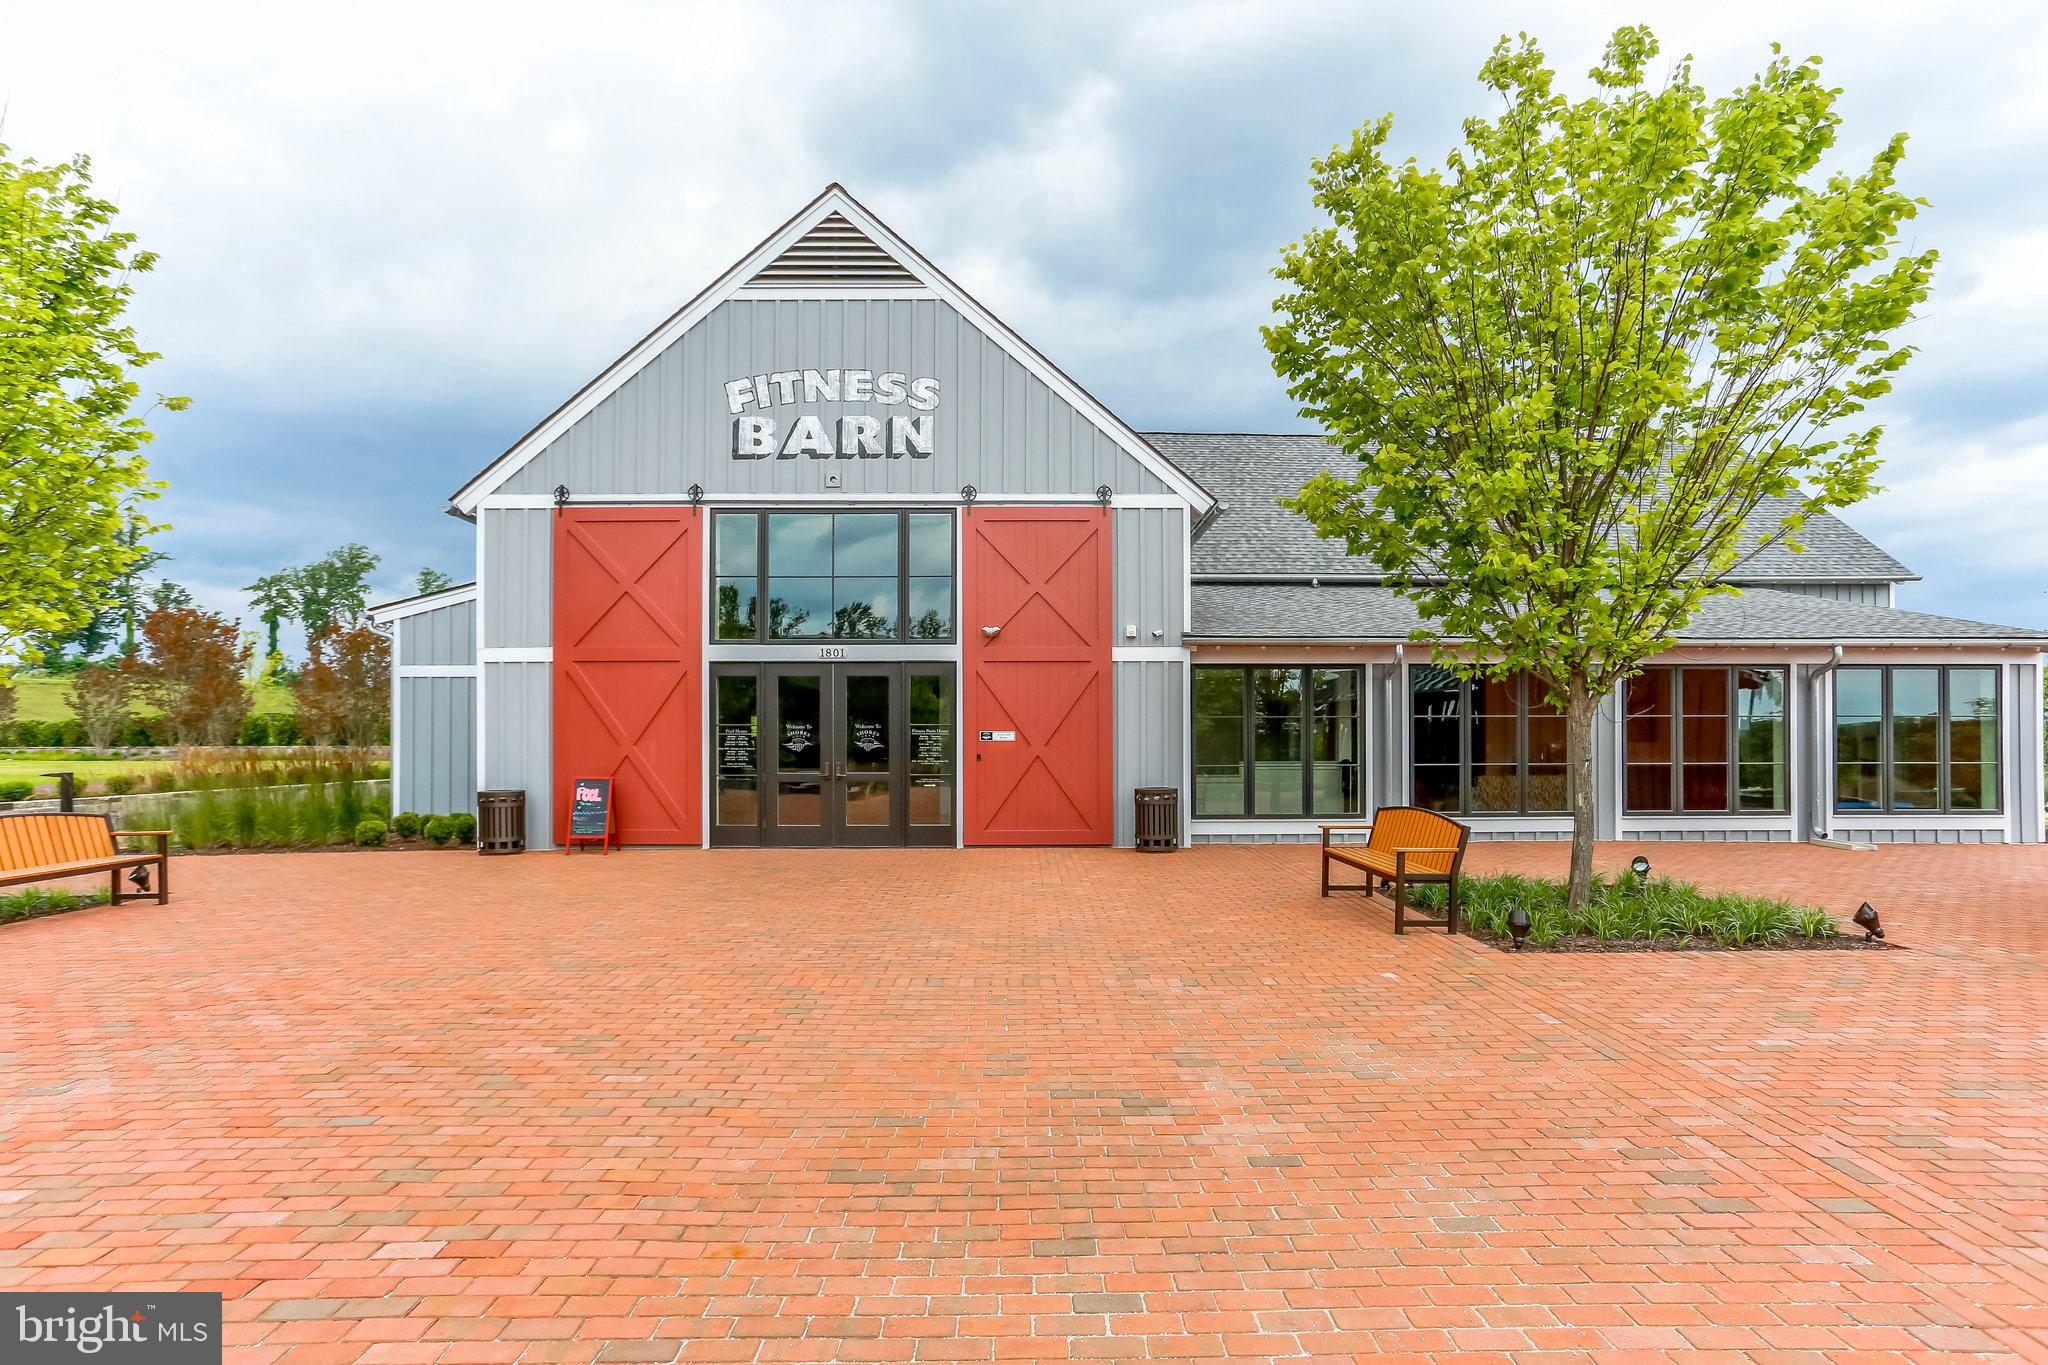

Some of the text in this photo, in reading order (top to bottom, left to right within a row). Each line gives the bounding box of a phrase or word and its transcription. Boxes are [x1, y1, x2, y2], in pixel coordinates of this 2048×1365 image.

[724, 369, 940, 414] FITNESS
[732, 415, 934, 460] BARN
[820, 648, 845, 658] 1801
